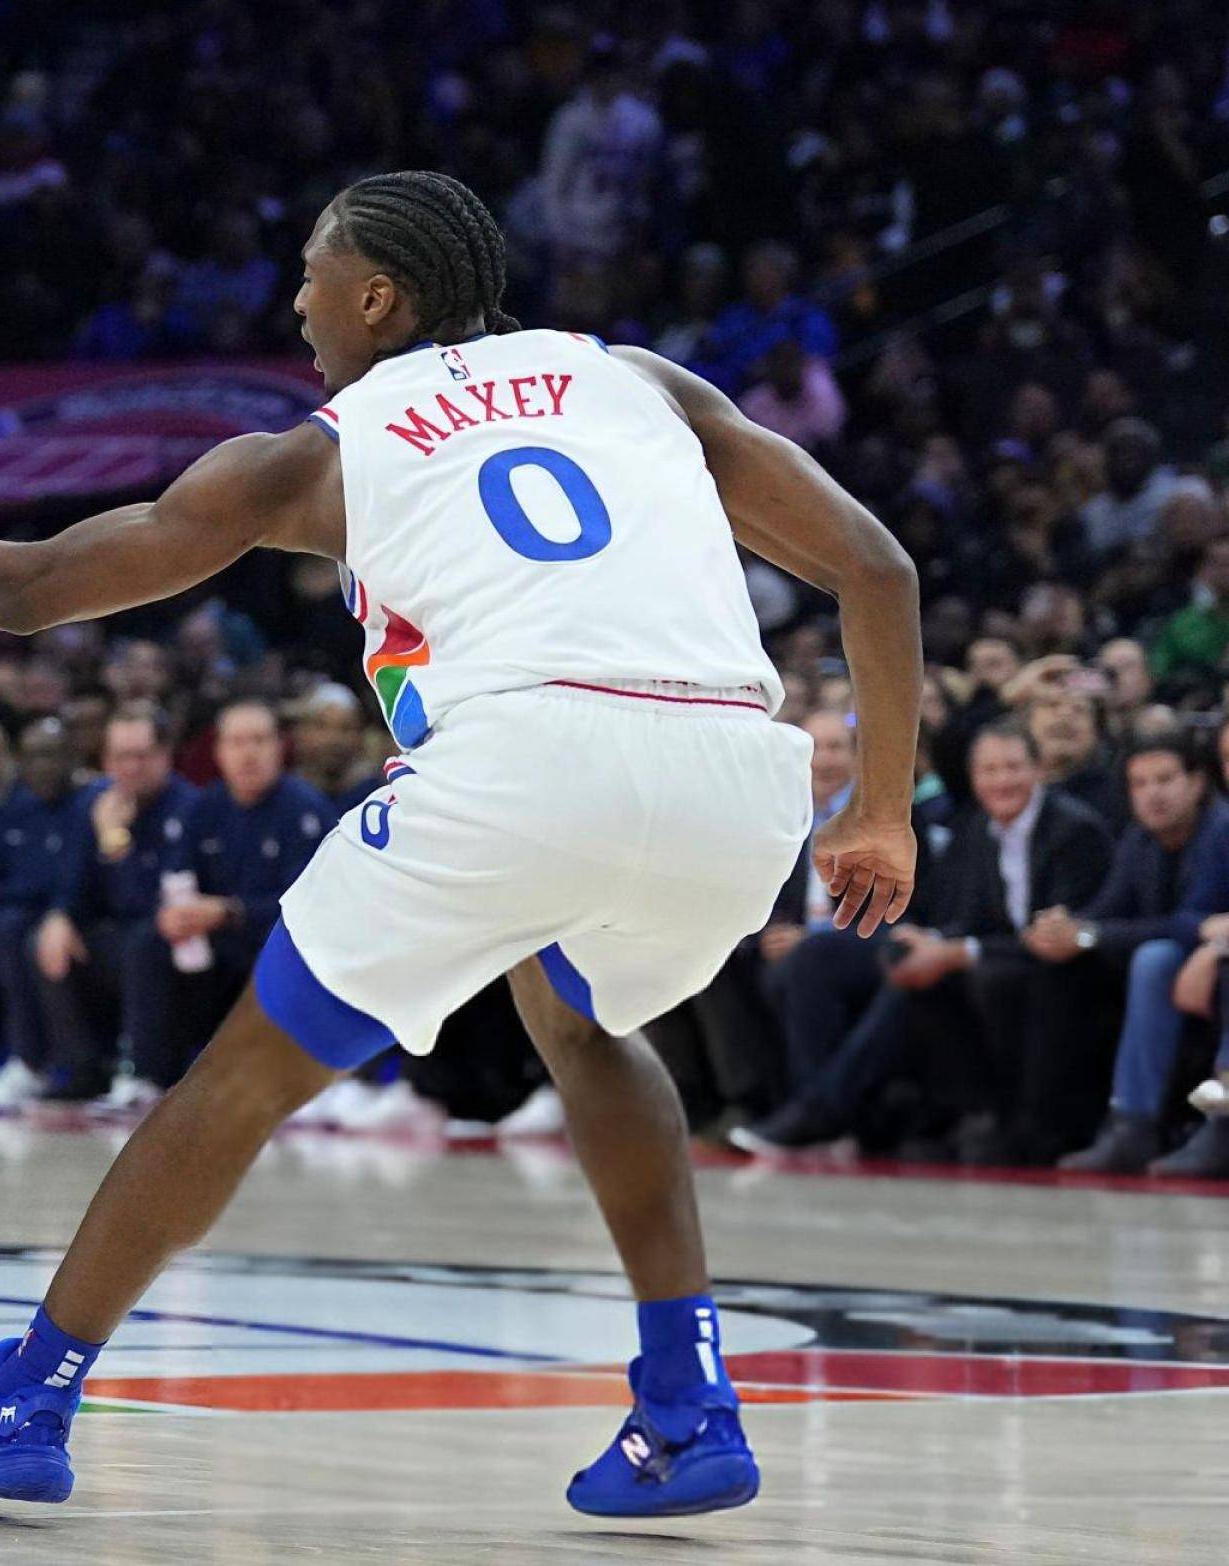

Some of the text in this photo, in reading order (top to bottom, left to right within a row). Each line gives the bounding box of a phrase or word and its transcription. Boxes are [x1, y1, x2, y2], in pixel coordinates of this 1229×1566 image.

[385, 374, 573, 456] MAXEY
[478, 446, 612, 562] 0
[360, 799, 392, 851] 0
